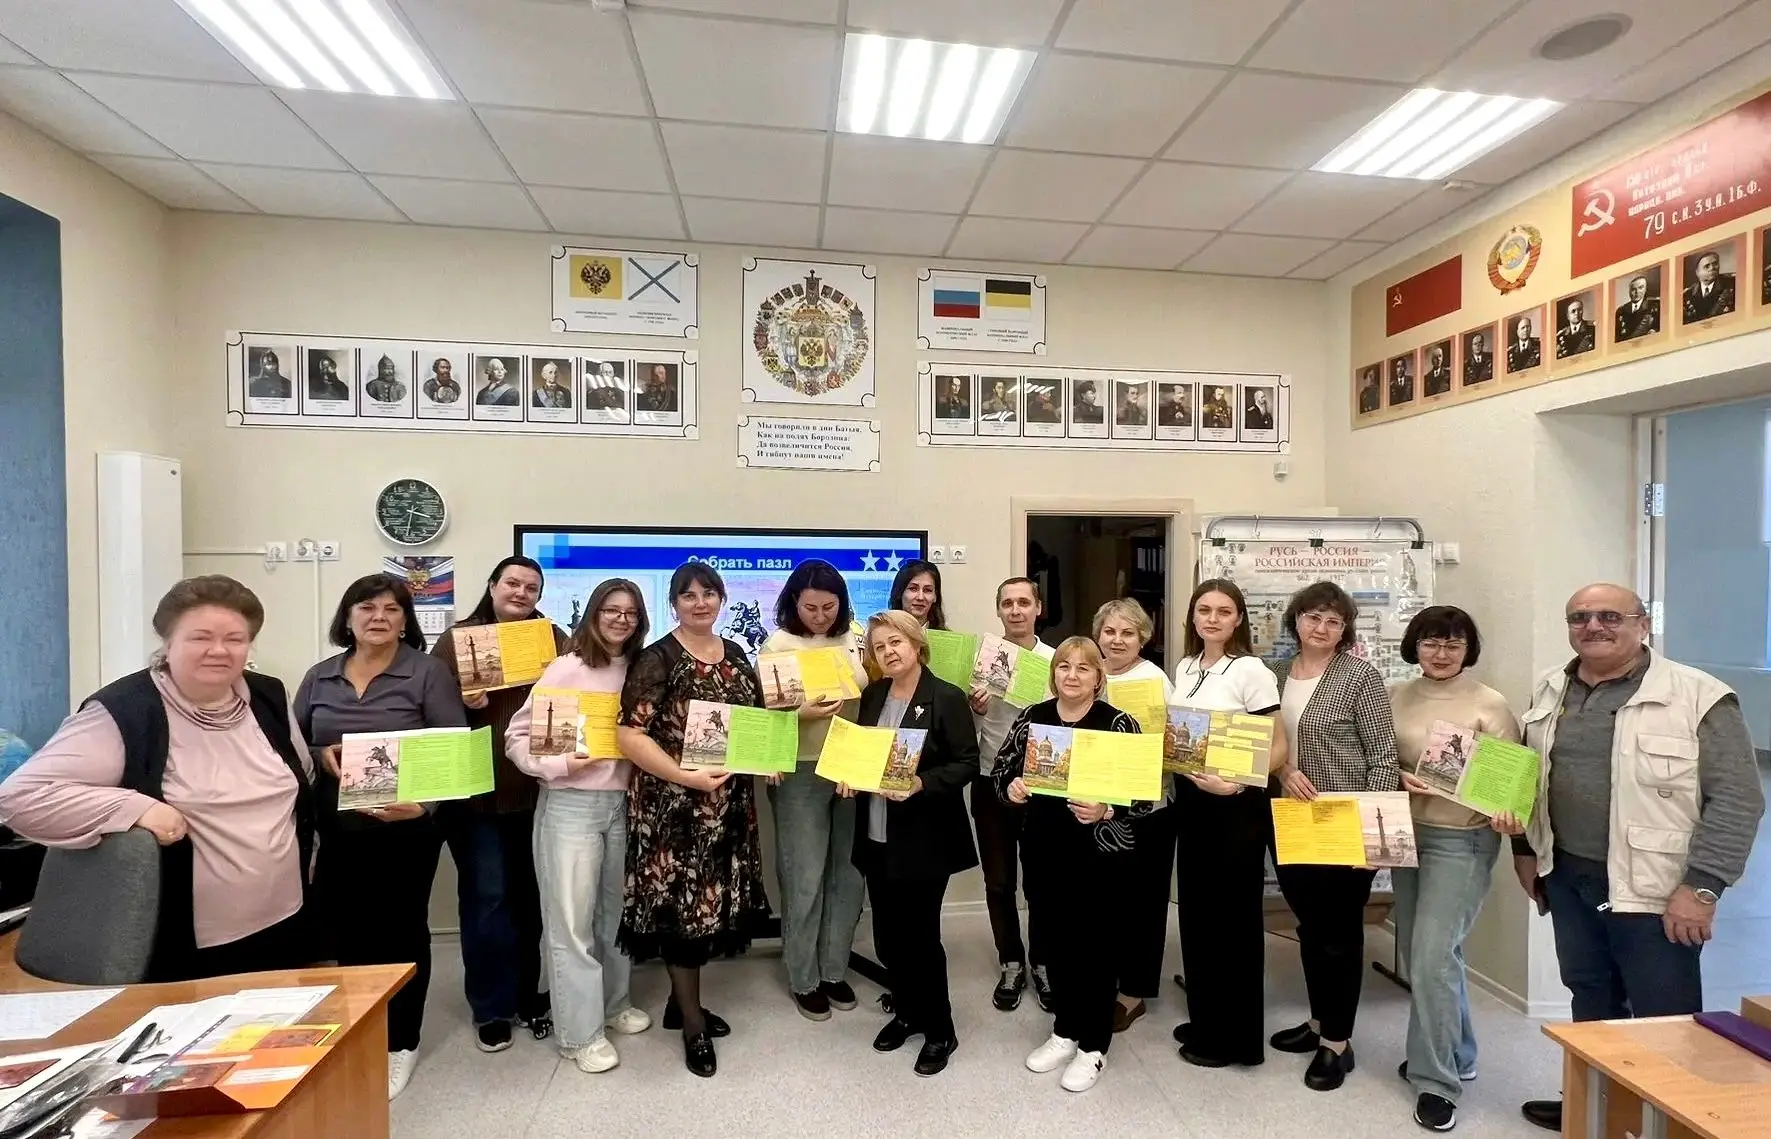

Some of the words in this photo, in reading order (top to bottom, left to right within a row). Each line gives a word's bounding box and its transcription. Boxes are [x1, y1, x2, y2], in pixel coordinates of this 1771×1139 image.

[1644, 211, 1665, 240] 79
[774, 423, 810, 431] говорили
[1270, 547, 1298, 556] РУСЬ
[1313, 547, 1359, 555] РОССИЯ
[757, 558, 792, 569] пазл
[1255, 557, 1330, 567] РОССИЙСКАЯ
[1333, 557, 1386, 567] ИМПЕР
